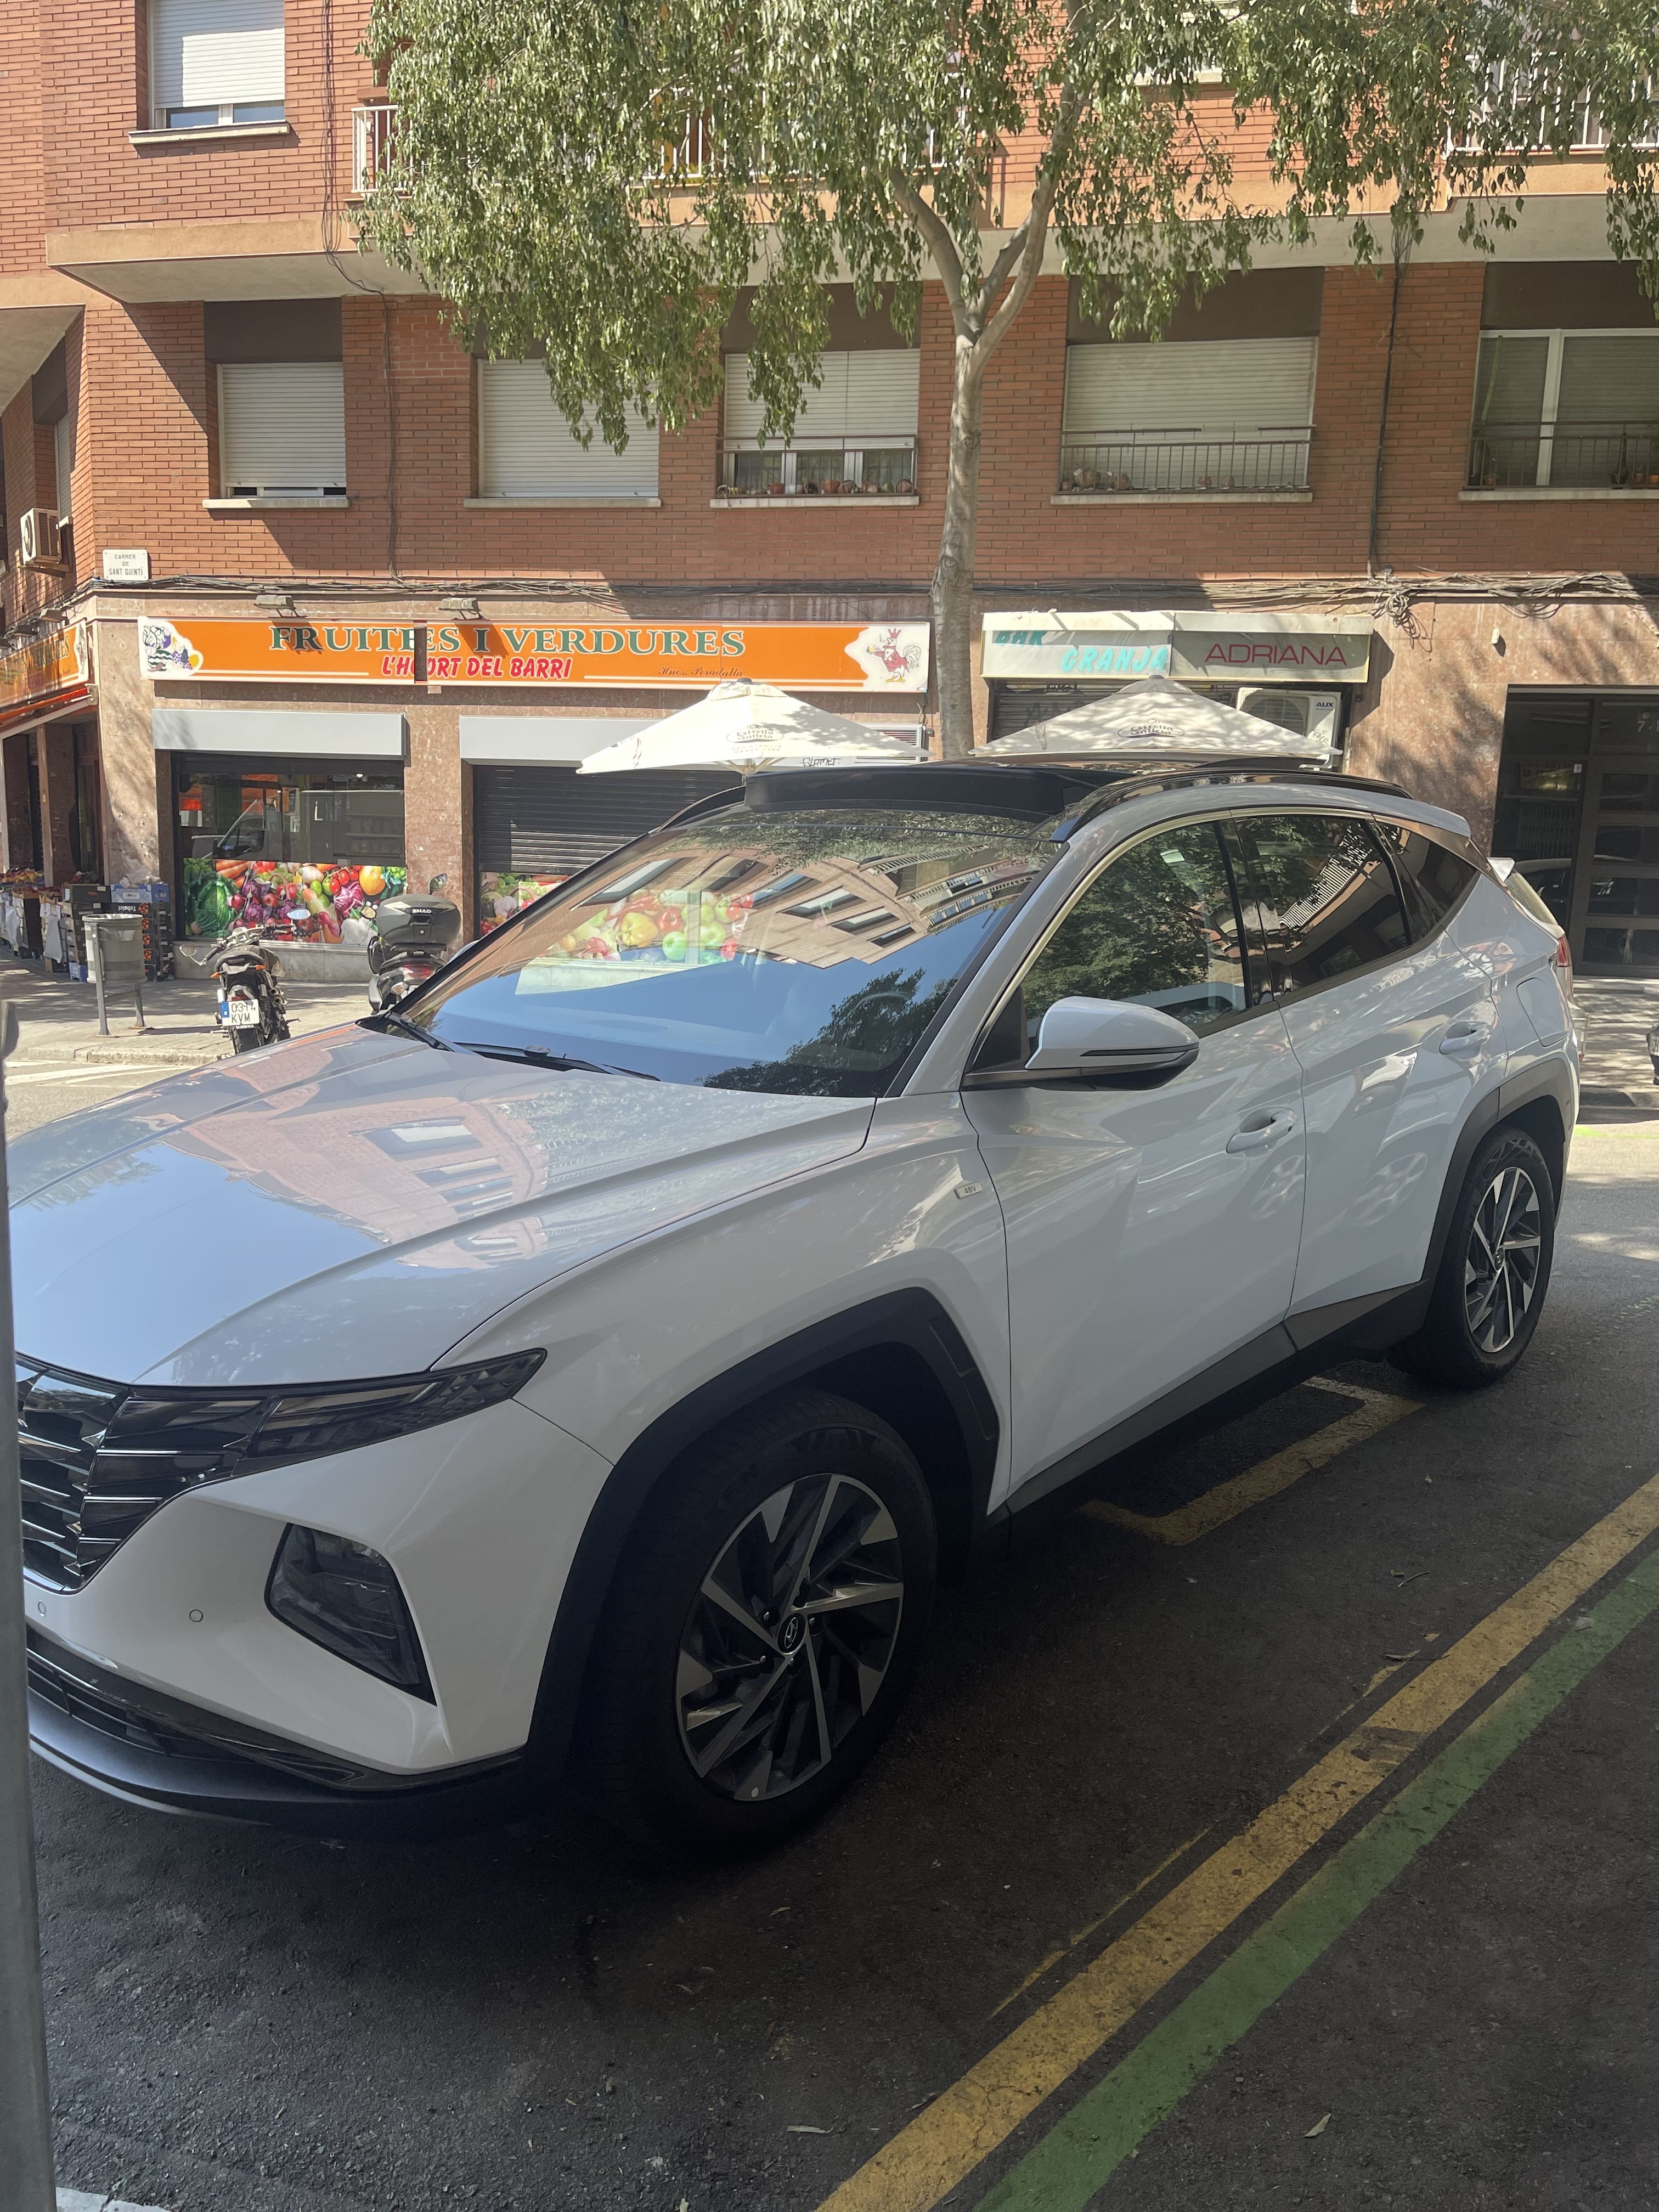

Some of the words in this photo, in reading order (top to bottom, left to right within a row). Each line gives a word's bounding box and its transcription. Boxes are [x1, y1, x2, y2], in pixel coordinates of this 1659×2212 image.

[269, 627, 460, 652] FRUITES
[474, 628, 490, 652] I
[501, 628, 746, 656] VERDURES
[1061, 647, 1168, 672] GRANJA
[1204, 644, 1347, 665] ADRIANA
[466, 657, 504, 677] DEL
[510, 657, 572, 679] BARRI
[232, 1013, 250, 1023] KVM
[964, 1185, 977, 1194] 48V
